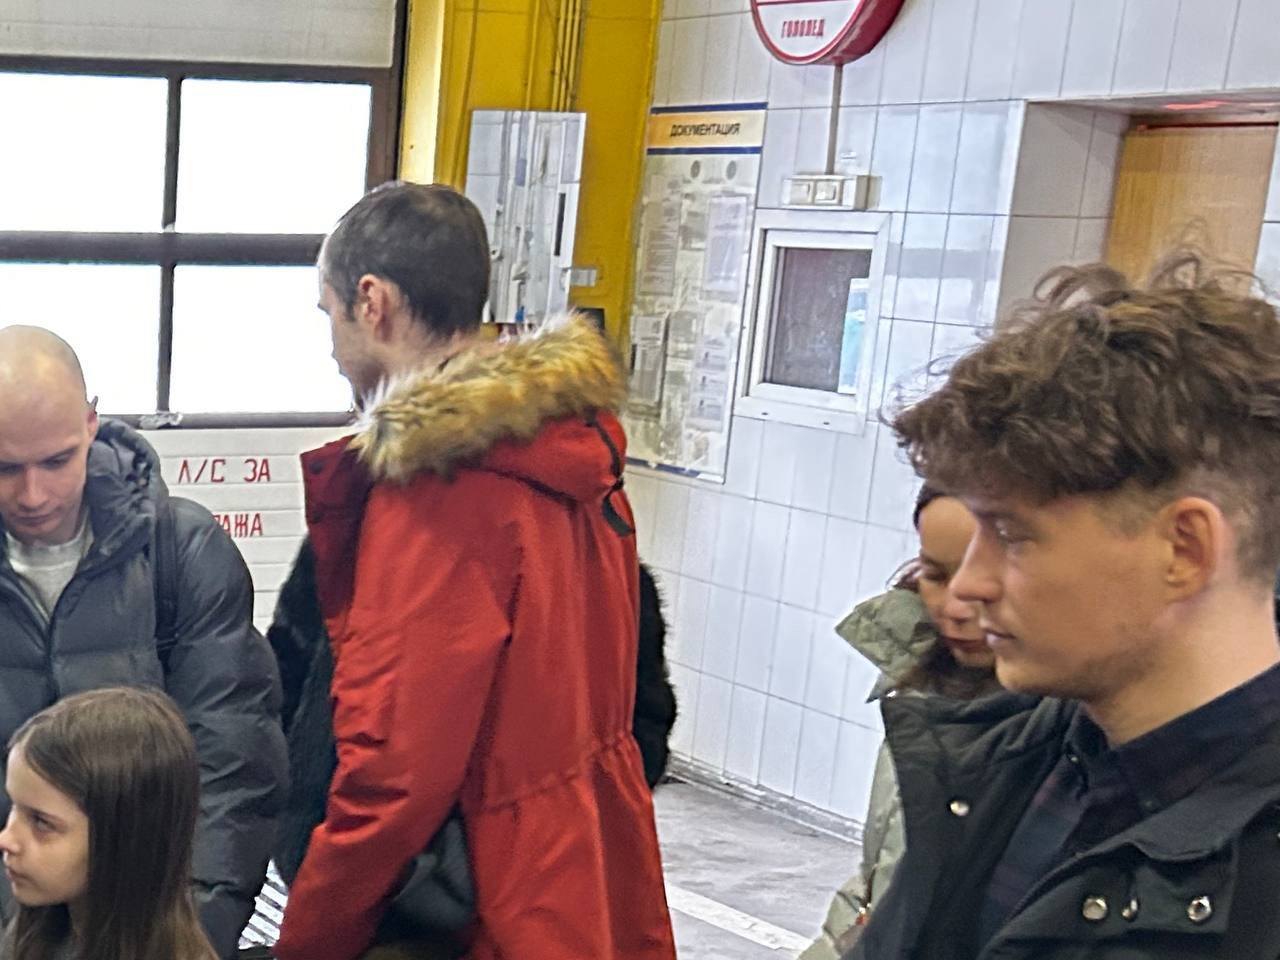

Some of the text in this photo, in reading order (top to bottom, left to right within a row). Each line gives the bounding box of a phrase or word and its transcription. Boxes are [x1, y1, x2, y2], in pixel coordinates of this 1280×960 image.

[669, 123, 741, 137] ДОКУМЕНТАЦИЯ
[178, 458, 271, 484] Л/С ЗА
